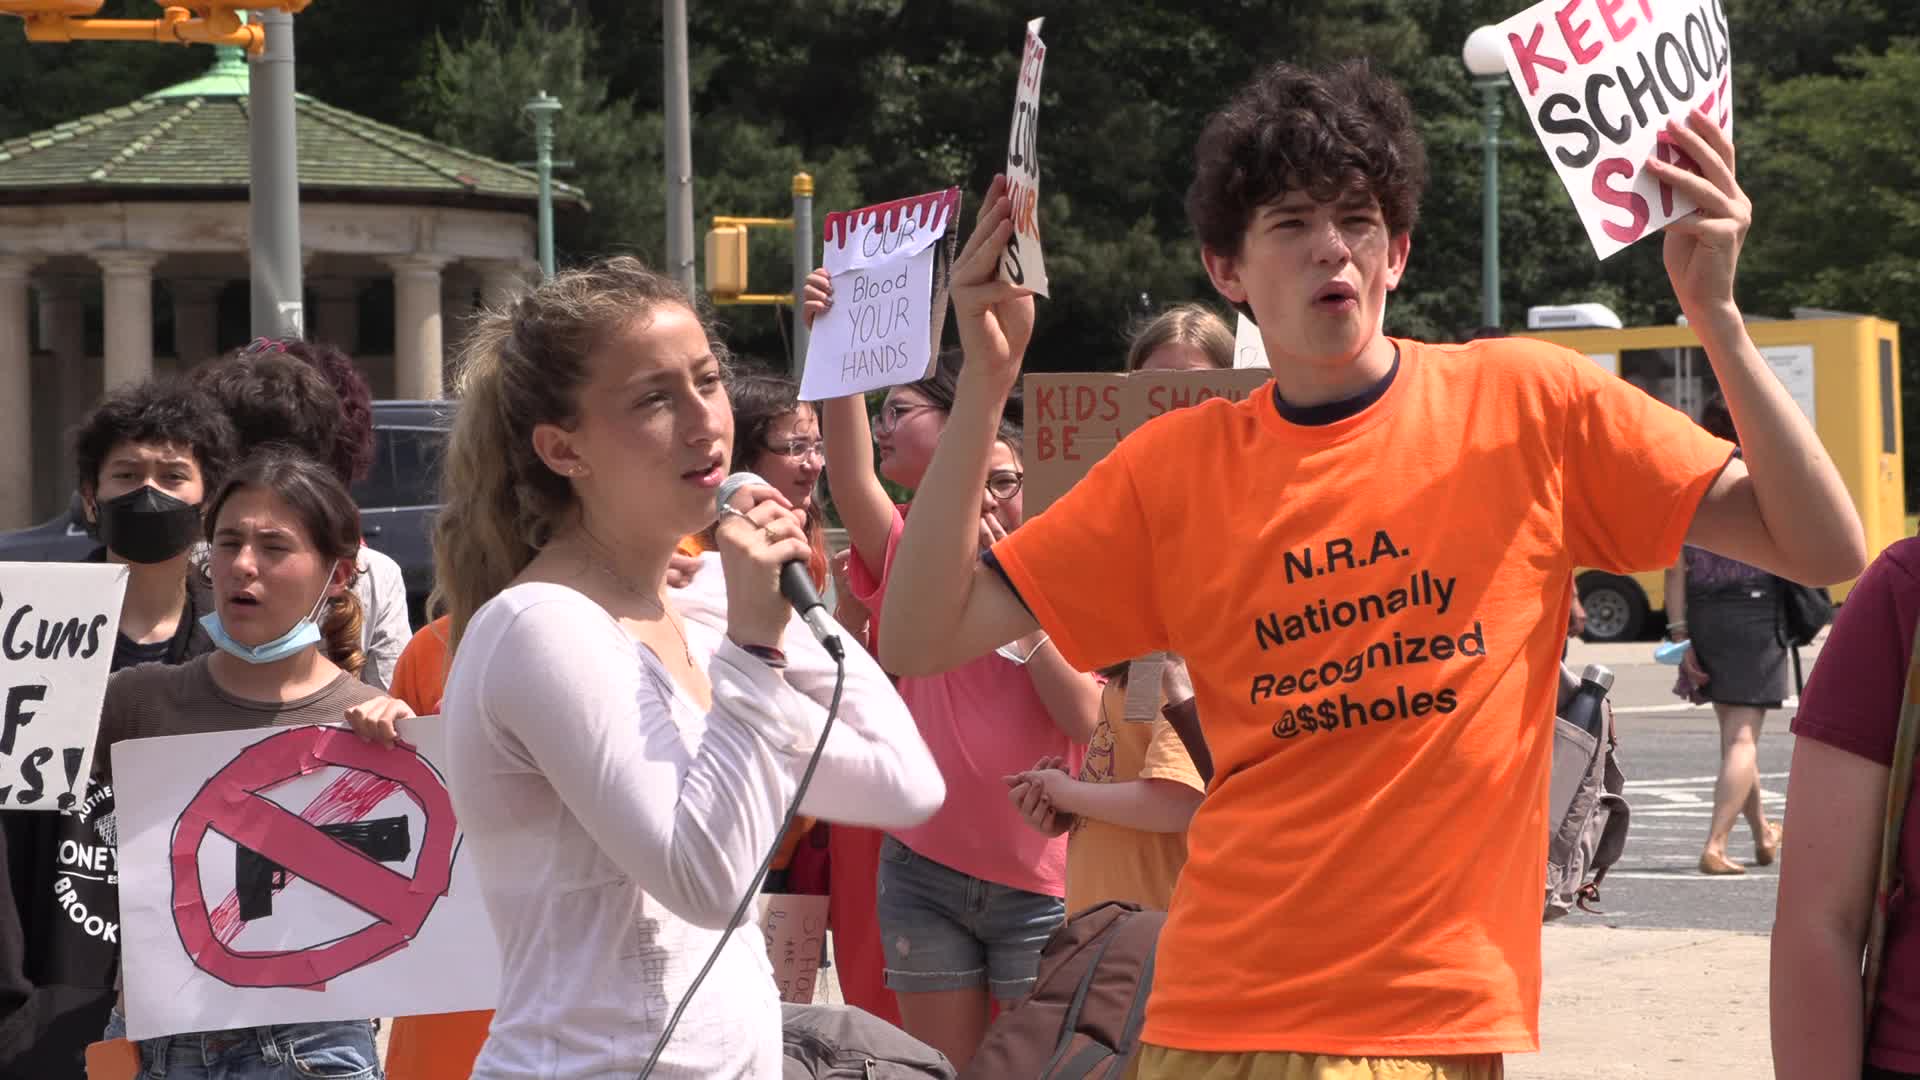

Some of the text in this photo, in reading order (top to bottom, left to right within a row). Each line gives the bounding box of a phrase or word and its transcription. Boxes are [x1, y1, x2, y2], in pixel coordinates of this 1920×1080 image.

[1508, 0, 1654, 96] KEE
[863, 218, 917, 258] OUR
[853, 265, 908, 303] Blood
[848, 296, 911, 349] YOUR
[841, 342, 909, 383] HANDS
[1036, 385, 1121, 422] KIDS
[1037, 425, 1081, 461] BE
[1284, 530, 1409, 584] N.R.A.
[2, 604, 108, 661] GUNS
[1255, 569, 1456, 650] Nationally
[1250, 621, 1486, 704] Recognized
[1272, 685, 1457, 739] @$$holes
[56, 840, 119, 871] ONEY
[54, 876, 119, 943] BROOK
